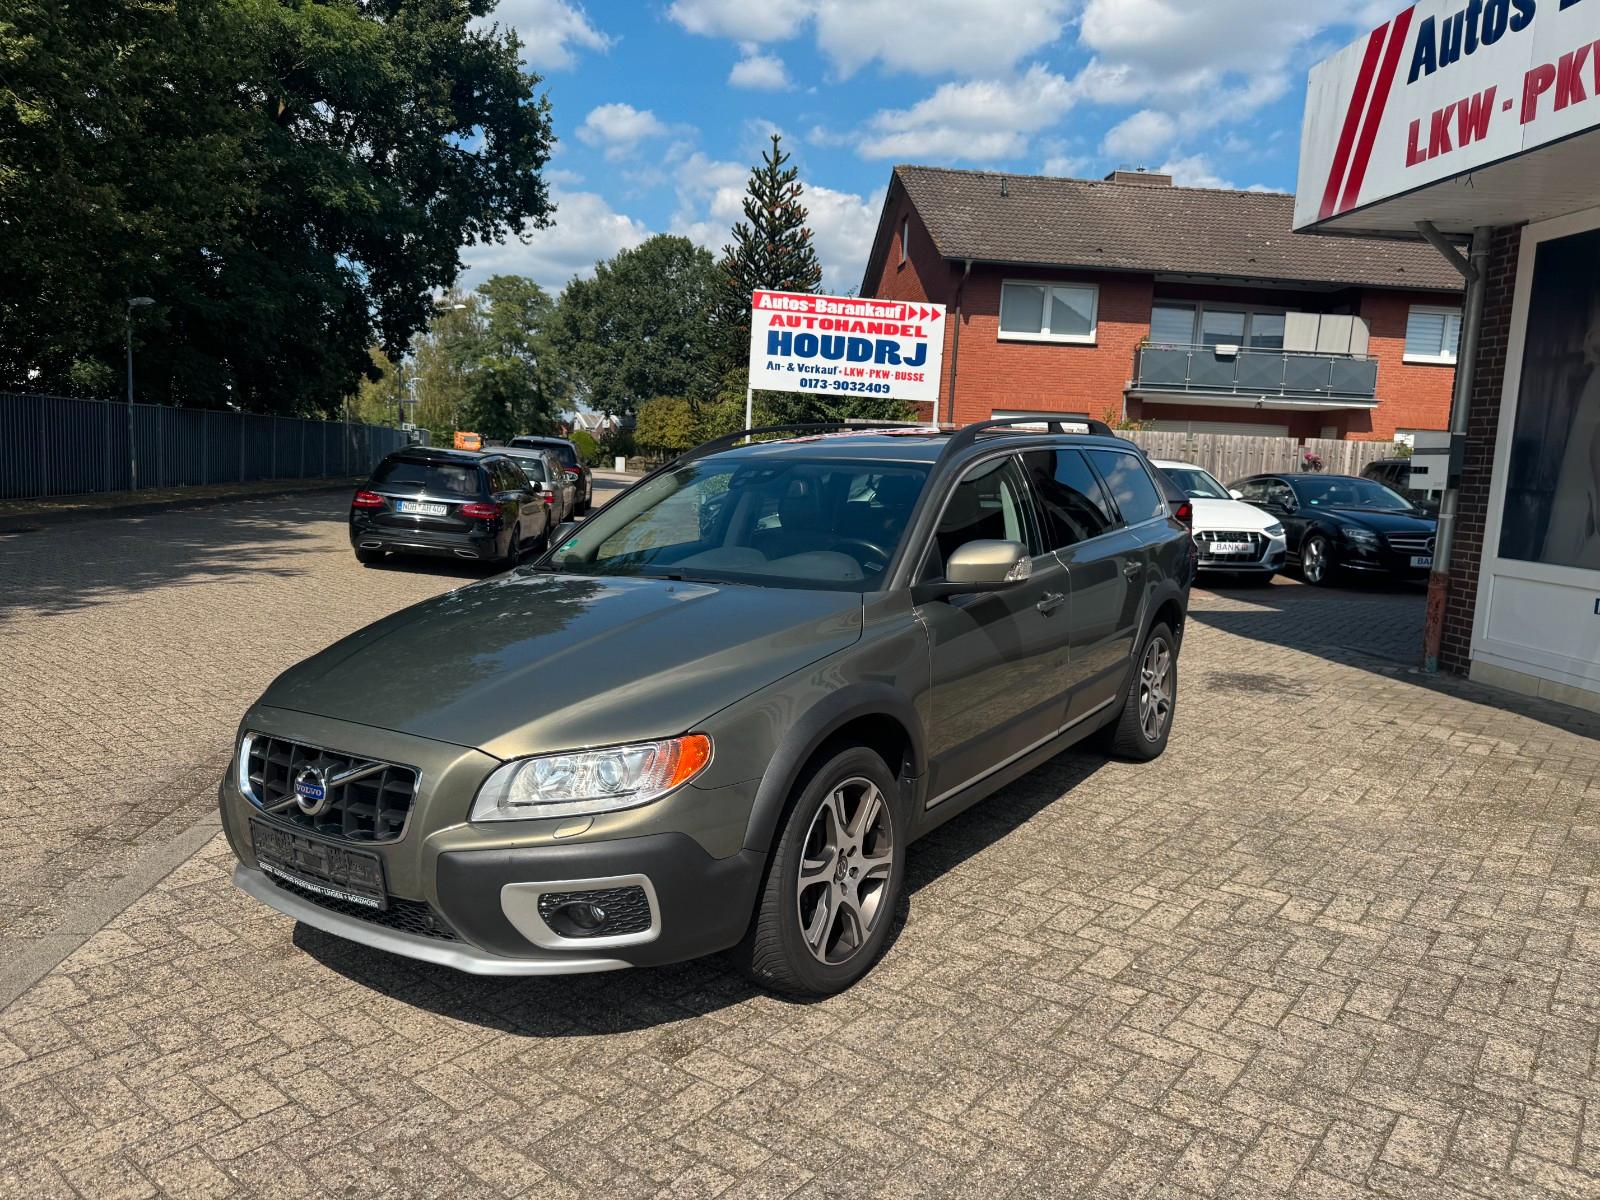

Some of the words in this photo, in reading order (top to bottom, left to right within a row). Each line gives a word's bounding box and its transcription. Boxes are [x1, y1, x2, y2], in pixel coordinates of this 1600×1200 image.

[1407, 0, 1536, 85] Autos
[1405, 85, 1497, 168] LKW
[1520, 39, 1600, 125] PK
[759, 294, 903, 319] Autos-Barankauf
[769, 314, 927, 338] AUTOHANDEL
[767, 330, 927, 367] HOUDRJ
[787, 362, 795, 372] &
[797, 363, 839, 376] Verkauf
[895, 371, 925, 382] BUSSE
[799, 377, 891, 394] 0173-9032409
[296, 784, 322, 796] VOLVO
